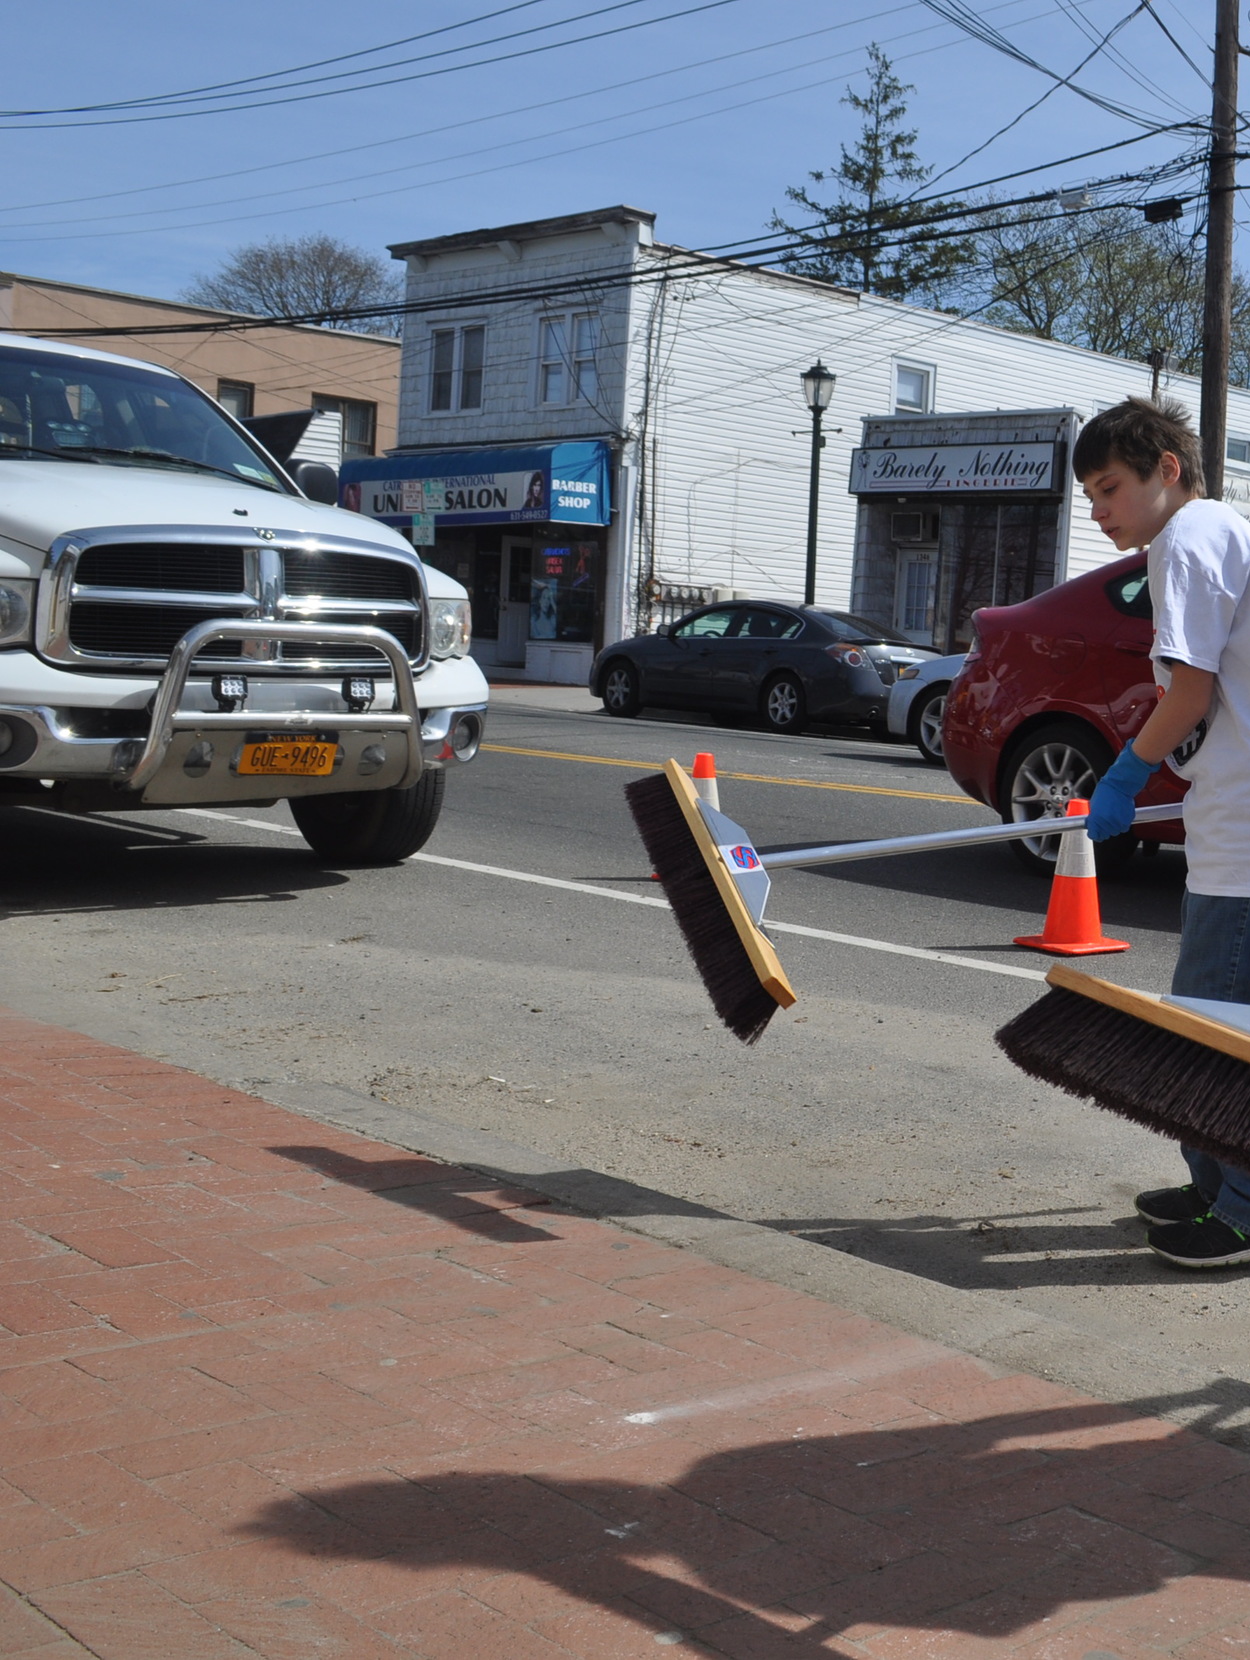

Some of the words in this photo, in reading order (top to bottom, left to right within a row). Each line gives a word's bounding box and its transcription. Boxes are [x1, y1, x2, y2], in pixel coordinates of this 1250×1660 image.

[872, 451, 946, 489] Barely
[958, 449, 1050, 488] Nothing
[552, 479, 597, 494] BARBER
[445, 487, 508, 510] SALON
[557, 495, 591, 509] SHOP
[290, 746, 329, 768] 9496
